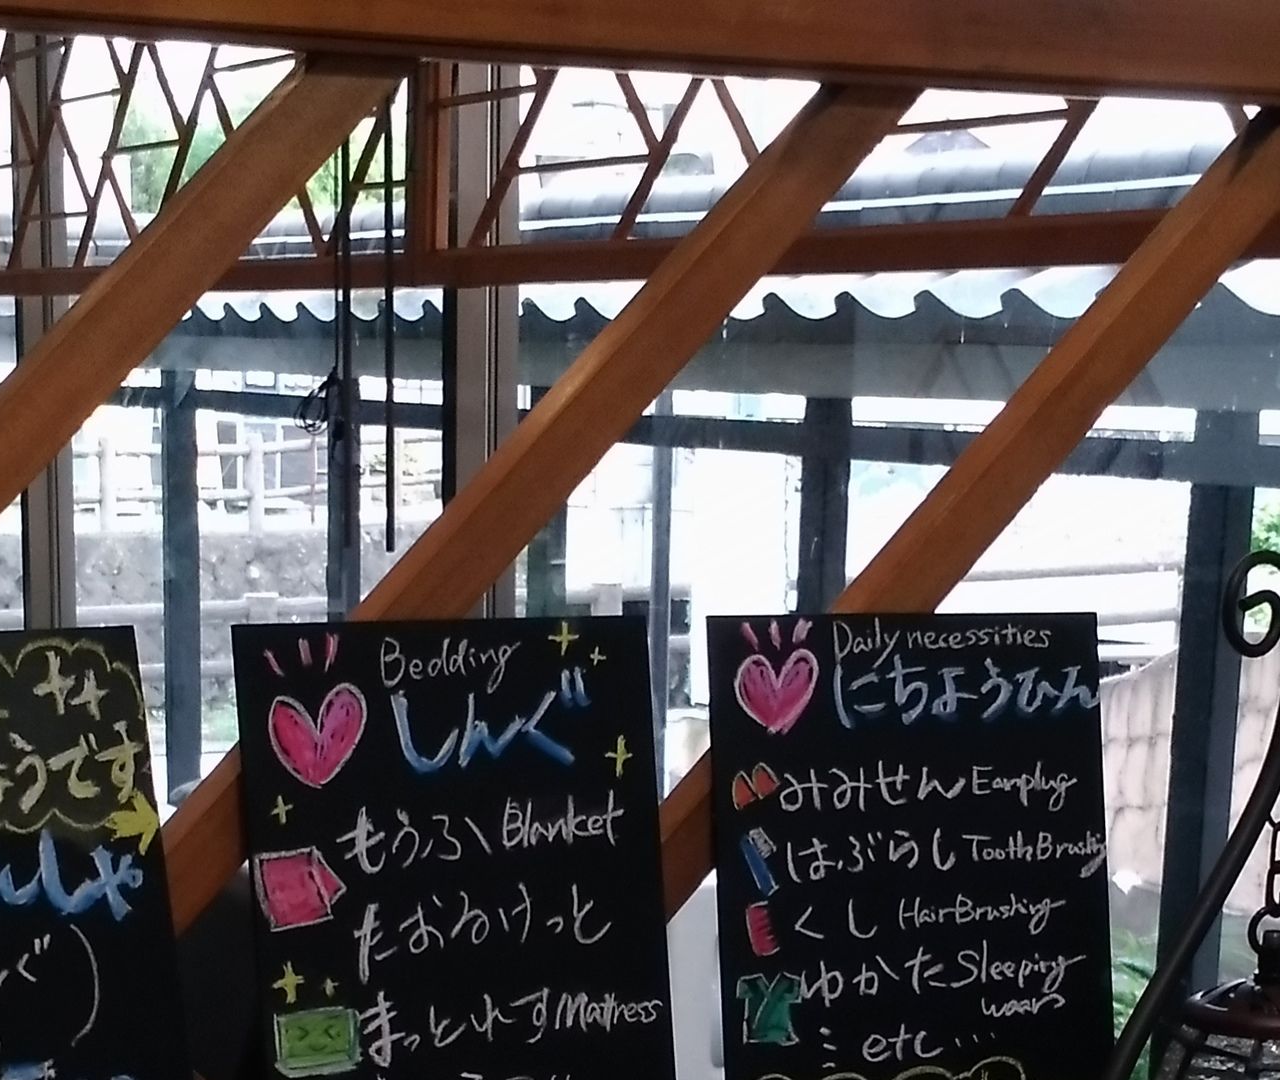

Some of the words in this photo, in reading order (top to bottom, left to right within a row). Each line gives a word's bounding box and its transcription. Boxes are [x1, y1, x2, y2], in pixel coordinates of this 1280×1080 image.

[380, 636, 521, 694] Bedding
[833, 618, 900, 668] Daily
[906, 622, 1052, 649] necessities
[390, 666, 592, 775] しんぐ
[779, 760, 967, 812] みみせん
[336, 806, 491, 875] もうふ
[502, 788, 625, 850] Blanket
[786, 827, 956, 883] はぶらし
[353, 883, 612, 983] たおるけっと
[794, 898, 879, 939] くし
[800, 946, 948, 1008] ゆかた
[949, 940, 1087, 995] Sleeping
[358, 987, 550, 1068] まっとれす
